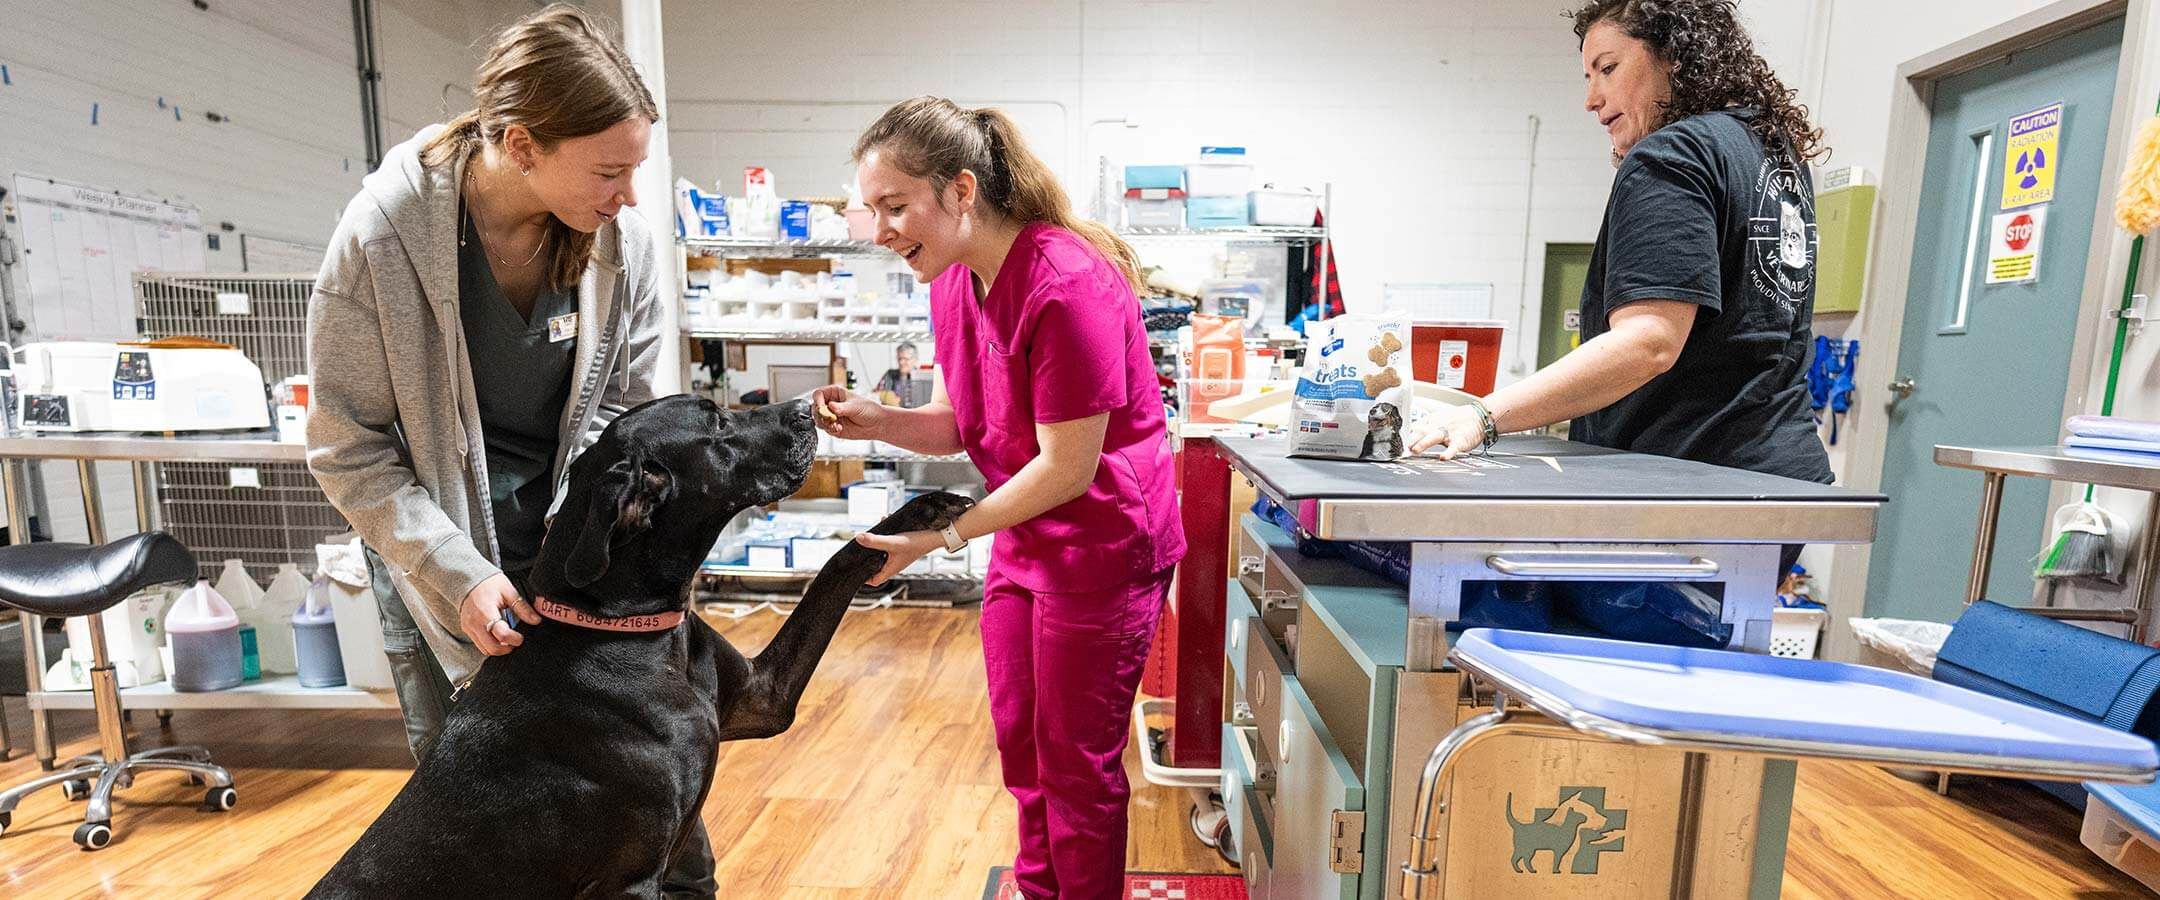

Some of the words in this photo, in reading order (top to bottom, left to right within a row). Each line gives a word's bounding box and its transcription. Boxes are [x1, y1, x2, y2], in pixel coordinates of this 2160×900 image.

[2012, 111, 2058, 134] CAUTION
[2011, 131, 2055, 148] RADIATION
[74, 187, 114, 208] Weekly
[117, 194, 157, 214] Planner
[2004, 192, 2027, 205] X-RAY
[2030, 188, 2051, 200] AREA
[2006, 223, 2032, 242] STOP
[1750, 268, 1780, 304] PROUDLY
[1315, 363, 1357, 383] treats
[541, 600, 571, 618] DART
[576, 610, 660, 628] 6084721645
